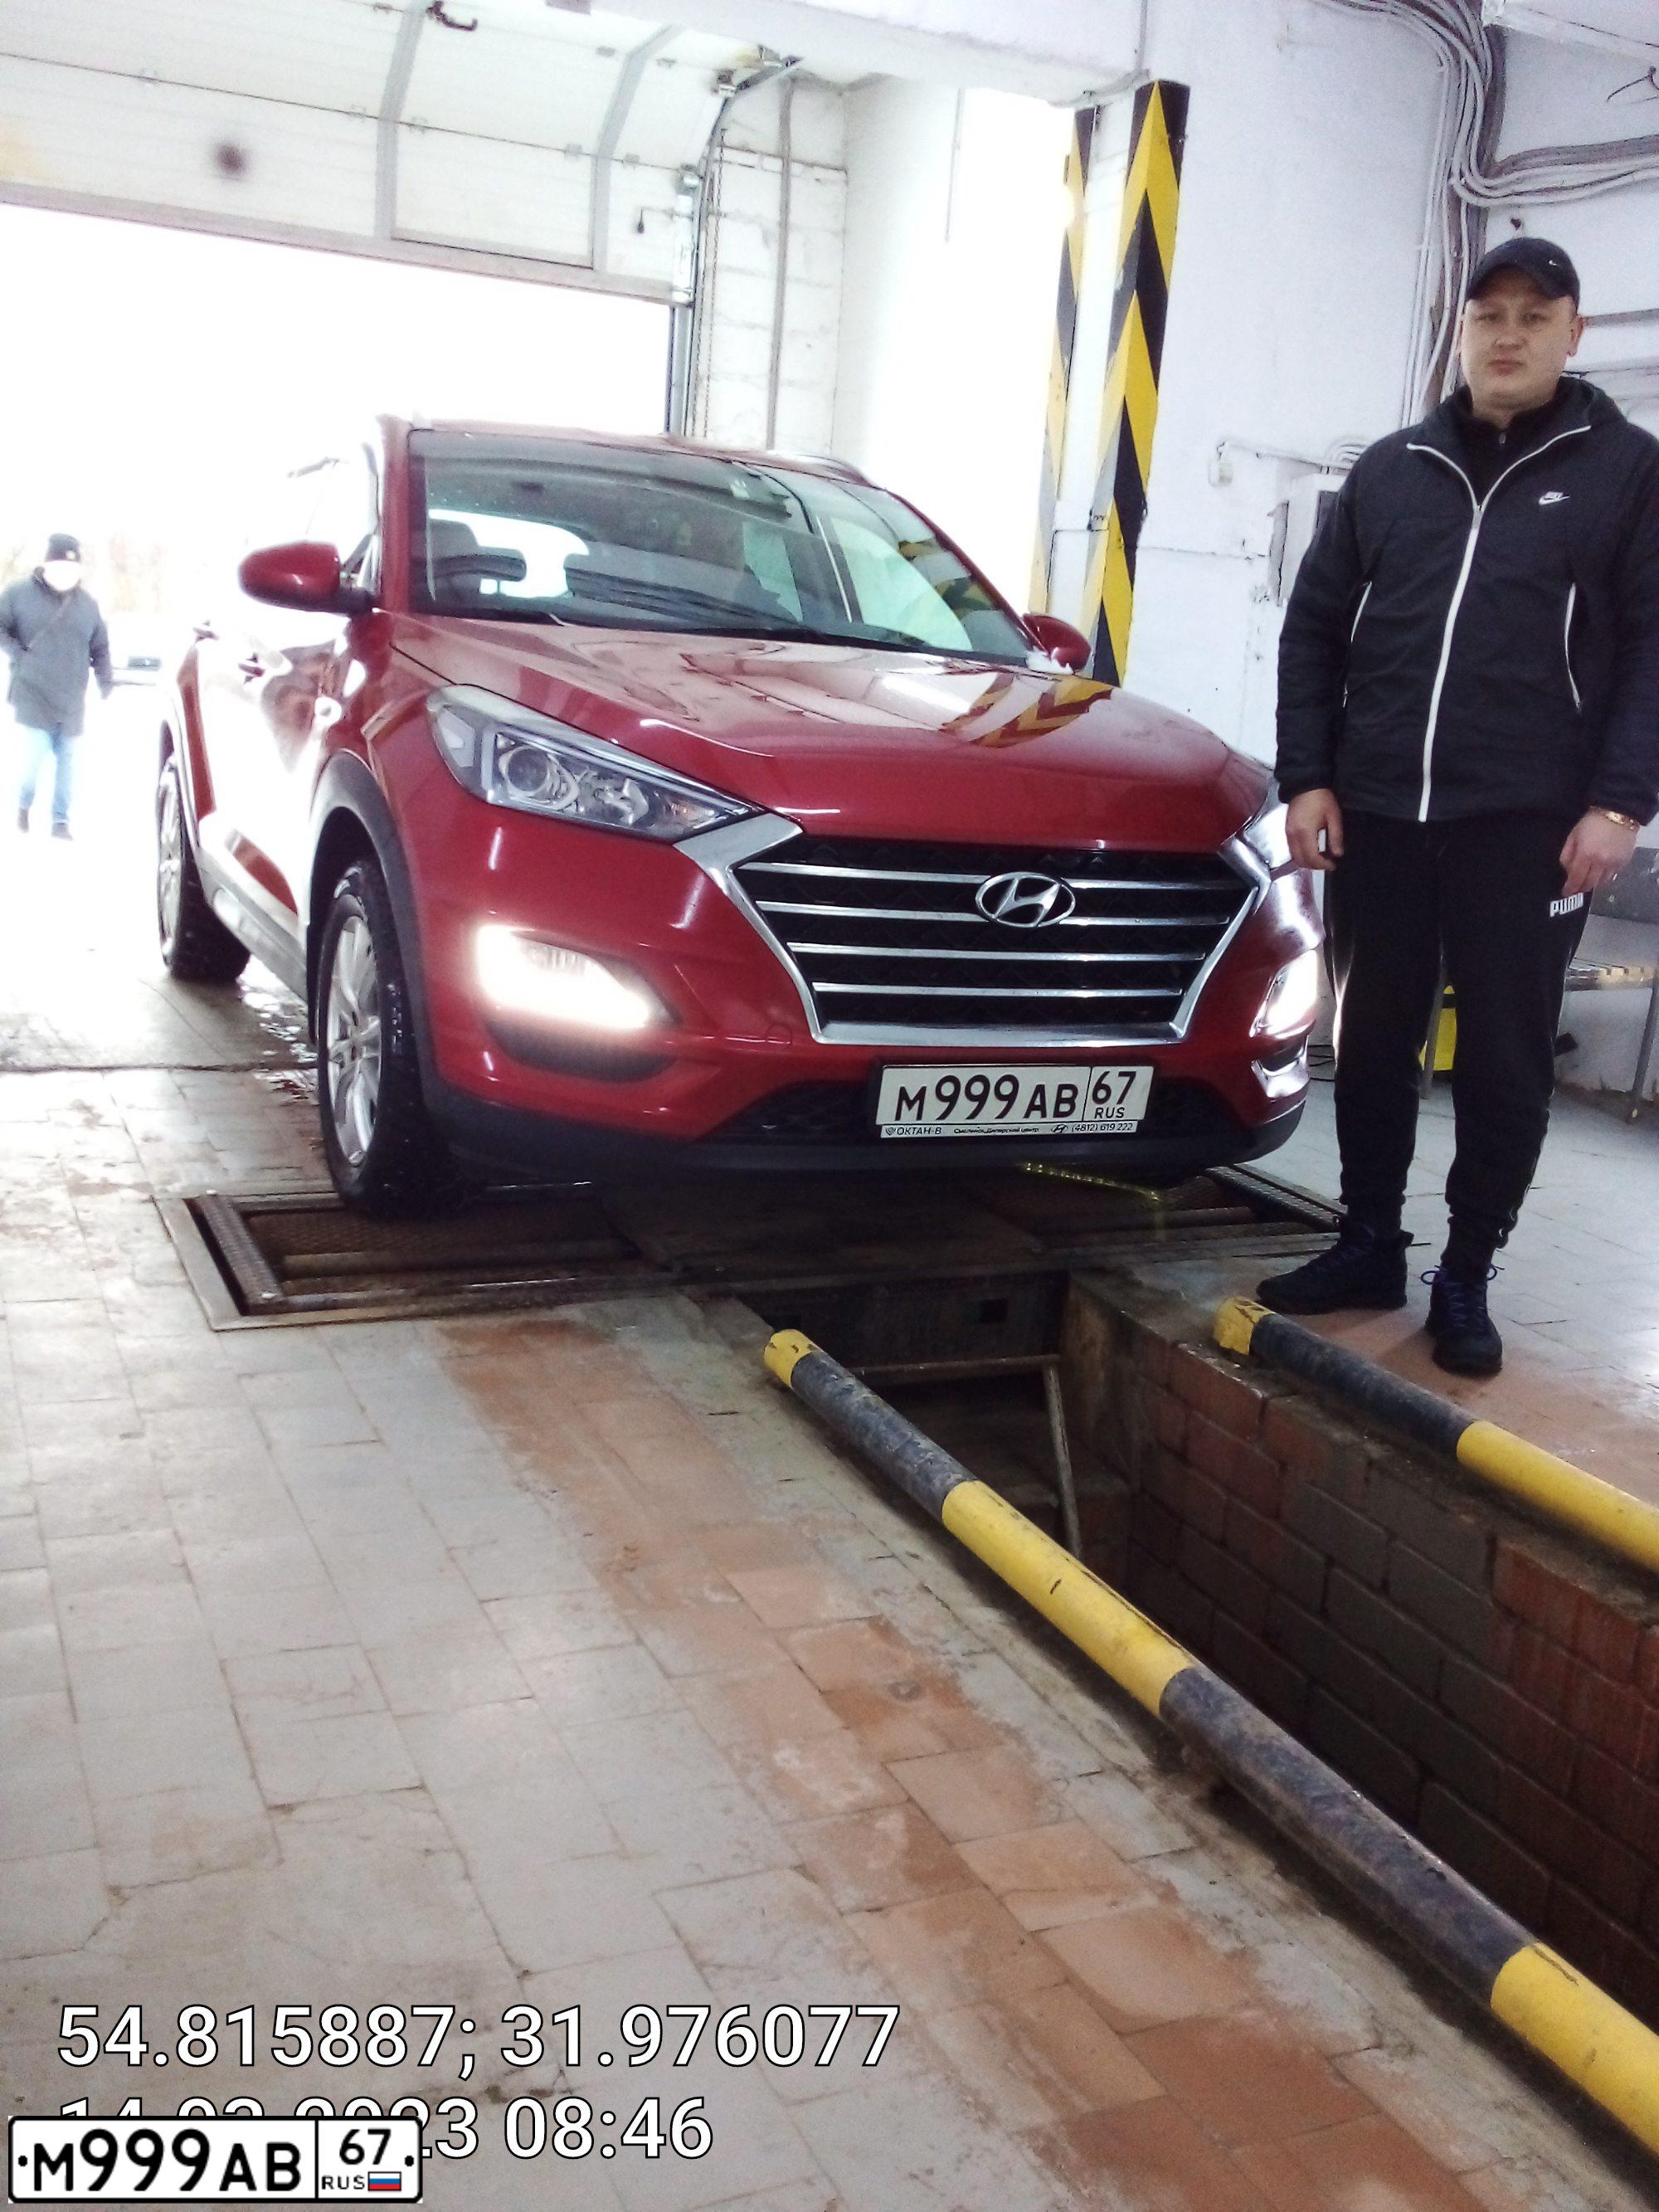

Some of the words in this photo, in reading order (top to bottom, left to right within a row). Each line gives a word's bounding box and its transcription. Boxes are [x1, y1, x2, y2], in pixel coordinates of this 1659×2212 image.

[894, 1074, 1079, 1121] М999АВ
[1092, 1070, 1137, 1105] 67
[1094, 1107, 1125, 1119] RUS
[897, 1126, 942, 1136] ОКТАН-В
[1072, 1123, 1098, 1132] (4812)
[1100, 1123, 1117, 1132] 619
[1117, 1123, 1133, 1131] 222
